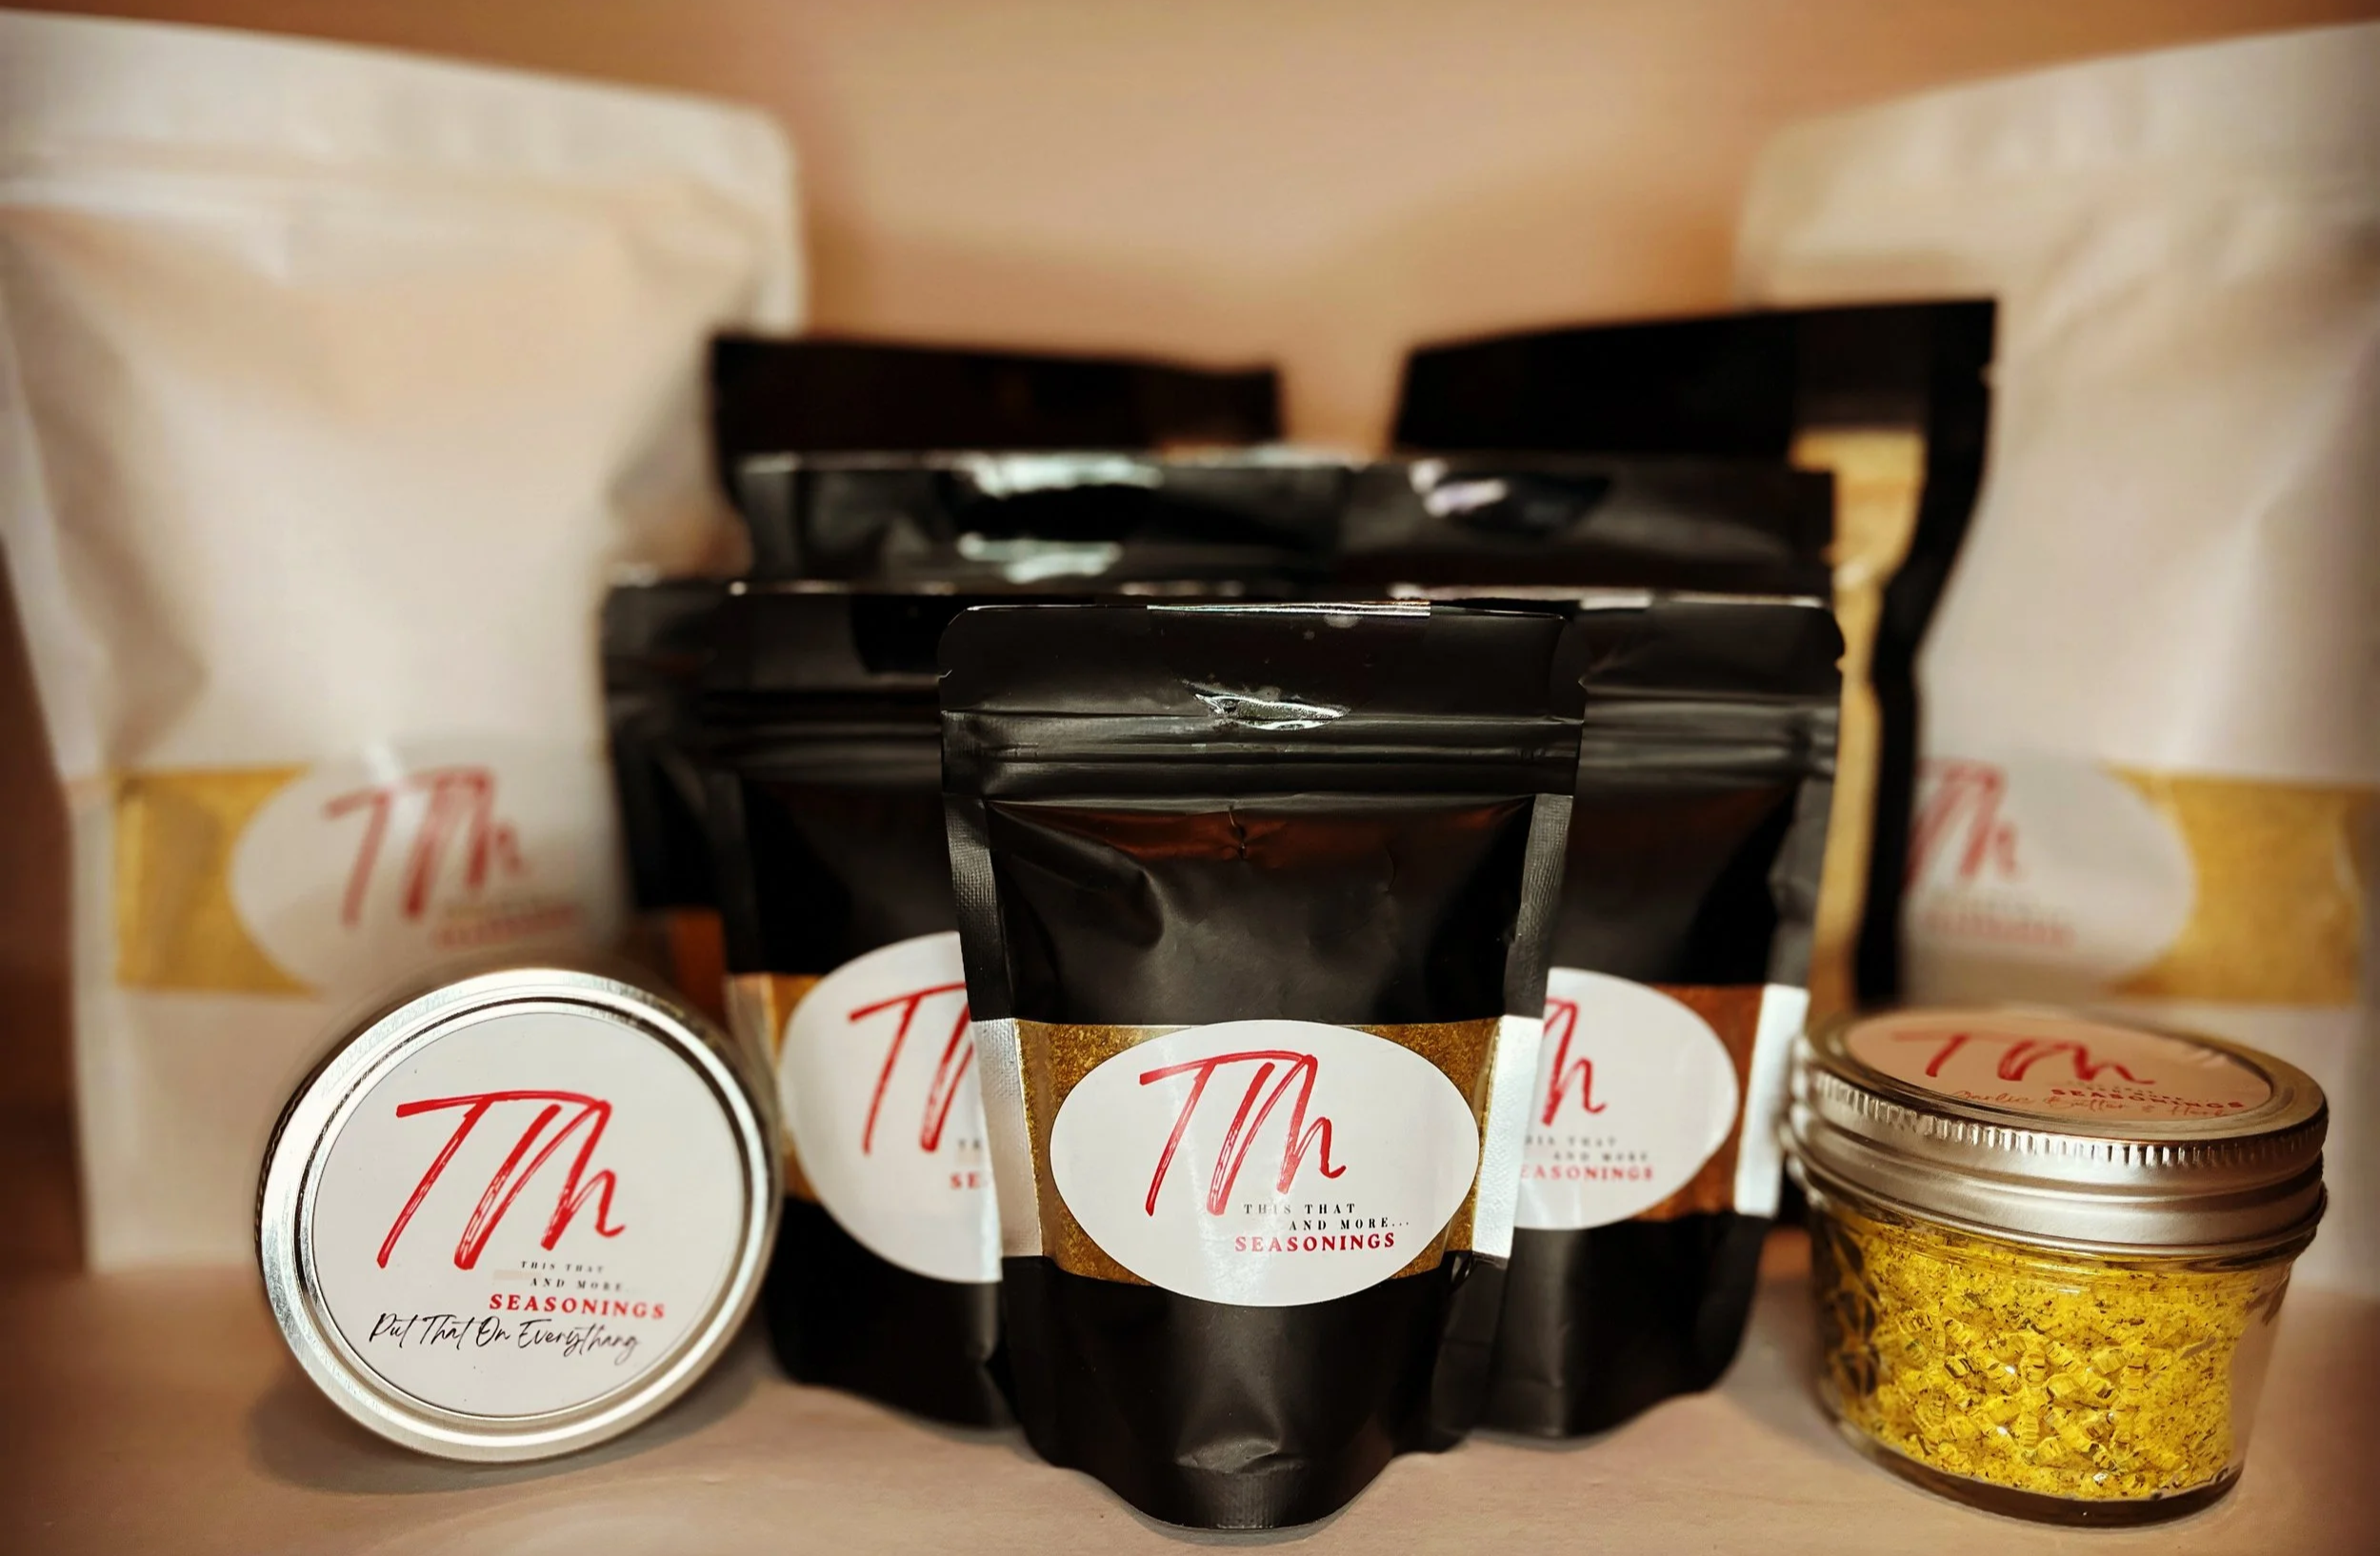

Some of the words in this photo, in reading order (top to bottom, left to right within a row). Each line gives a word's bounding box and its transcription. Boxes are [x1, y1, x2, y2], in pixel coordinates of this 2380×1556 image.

[2050, 1088, 2245, 1109] SEASONINGS
[1520, 1165, 1653, 1182] EASONINGS
[1244, 1204, 1290, 1214] THIS
[1305, 1204, 1355, 1214] THAT
[1289, 1220, 1327, 1231] AND
[1234, 1232, 1394, 1252] SEASONINGS
[521, 1261, 555, 1270] THIS
[565, 1264, 604, 1274] THAT
[530, 1277, 565, 1288] AND
[490, 1293, 665, 1320] SEASONINGS
[369, 1313, 422, 1347] Put
[420, 1314, 477, 1350] That
[475, 1315, 511, 1347] On
